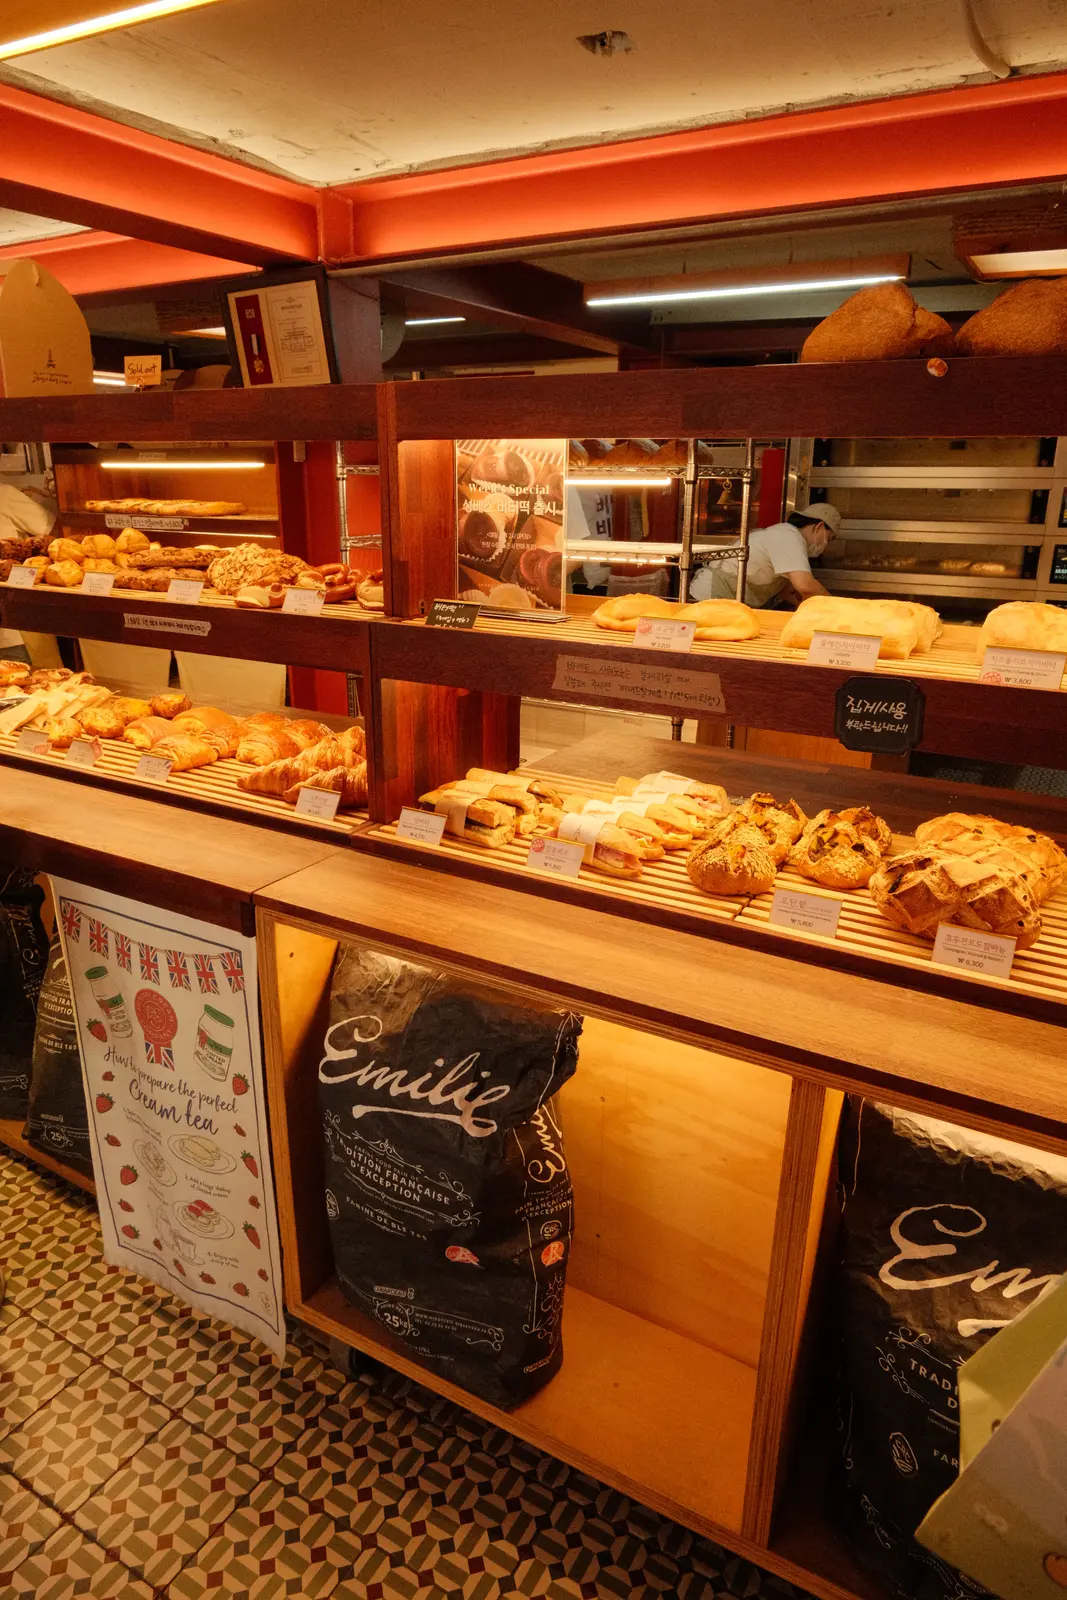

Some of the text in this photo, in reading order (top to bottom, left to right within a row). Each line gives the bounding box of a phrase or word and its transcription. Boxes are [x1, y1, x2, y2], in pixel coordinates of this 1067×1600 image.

[127, 362, 157, 374] Sold out
[509, 483, 549, 497] Special
[497, 500, 530, 515] 버터떡
[533, 500, 556, 516] 출시
[797, 919, 814, 928] 5,800
[965, 959, 984, 968] 6,300
[44, 1001, 73, 1015] D'EXCEPTIO
[204, 1047, 226, 1062] CLOTTED
[206, 1053, 223, 1065] CREAM
[103, 1045, 129, 1068] How
[138, 1069, 175, 1093] prepare
[177, 1079, 197, 1099] the
[198, 1090, 239, 1114] perfect
[318, 1014, 510, 1138] Emilie
[128, 1079, 183, 1124] Cream
[185, 1099, 219, 1135] tea
[375, 1156, 392, 1169] POUR
[393, 1166, 409, 1178] PAIN
[350, 1159, 421, 1203] D'EXCEPTION
[385, 1169, 451, 1206] FRANÇAISE
[345, 1196, 375, 1219] FARINE
[376, 1212, 388, 1225] DE
[514, 1200, 533, 1215] PAIN
[521, 1198, 573, 1222] D'EXCEPTION
[543, 1224, 559, 1234] CRC
[909, 1358, 958, 1396] TRADI
[933, 1449, 959, 1468] FAR
